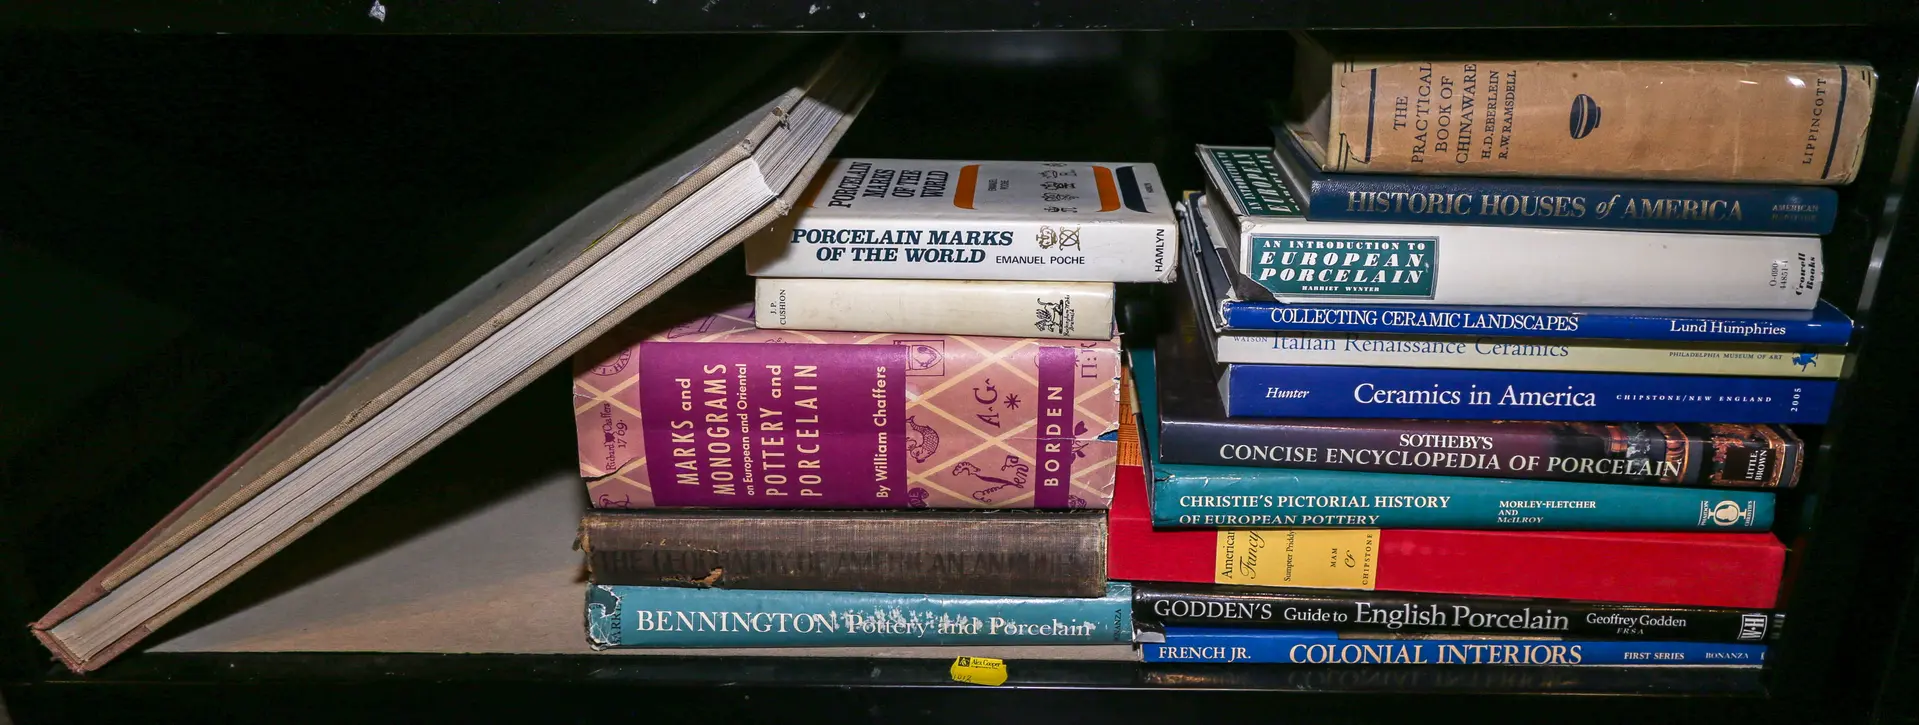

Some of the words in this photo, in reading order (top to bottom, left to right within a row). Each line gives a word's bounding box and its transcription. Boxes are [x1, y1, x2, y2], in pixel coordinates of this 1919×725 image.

[1441, 76, 1454, 102] OF
[1393, 96, 1408, 130] THE
[1411, 62, 1432, 164] PRACTICAL
[1456, 63, 1477, 164] CHINAWARE
[1802, 78, 1827, 165] LIPPINCOTT
[1434, 107, 1453, 153] BOOK
[828, 161, 873, 208] PORCELAIN
[862, 169, 896, 198] MARKS
[892, 183, 916, 198] OF
[901, 170, 922, 185] THE
[920, 170, 949, 198] WORLD
[1232, 152, 1292, 213] EUROPEAN
[1346, 190, 1472, 215] HISTORIC
[1479, 194, 1586, 218] HOUSES
[1595, 194, 1620, 219] of
[1621, 198, 1743, 221] AMERICA
[791, 228, 923, 245] PORCELAIN
[927, 230, 1014, 246] MARKS
[1155, 228, 1166, 272] HAMLYN
[1262, 240, 1281, 249] AN
[1289, 240, 1400, 250] INTRODUCTION
[1407, 242, 1426, 251] TO
[816, 247, 846, 261] OF
[850, 247, 898, 262] THE
[904, 248, 986, 263] WORLD
[996, 255, 1046, 265] EMANUEL
[1050, 256, 1085, 265] POCHE
[1259, 252, 1424, 267] EUROPEAN
[1259, 268, 1424, 284] PORCELAIN
[1795, 252, 1806, 295] Crowell
[1806, 256, 1816, 289] Books
[770, 300, 778, 315] J.P.
[779, 289, 787, 325] CUSHION
[1271, 307, 1378, 325] COLLECTING
[1381, 310, 1460, 328] CERAMIC
[1463, 313, 1579, 331] LANDSCAPES
[1670, 320, 1707, 333] Lund
[1710, 321, 1786, 336] Humphries
[1272, 331, 1336, 350] Italian
[1344, 333, 1466, 354] Renaissance
[1475, 337, 1569, 357] Ceramics
[675, 378, 691, 411] and
[735, 363, 747, 410] Oriental
[766, 364, 782, 399] and
[872, 366, 888, 426] Chaffers
[1266, 387, 1310, 399] Hunter
[1354, 383, 1461, 405] Ceramics
[1468, 385, 1491, 405] in
[1497, 386, 1596, 407] America
[1791, 388, 1801, 412] 2005
[703, 364, 736, 496] MONOGRAMS
[737, 413, 748, 434] and
[794, 365, 823, 497] PORCELAIN
[1043, 386, 1063, 487] BORDEN
[670, 420, 700, 486] MARKS
[759, 408, 788, 496] POTTERY
[1399, 433, 1493, 449] SOTHEBY'S
[606, 443, 617, 471] Richard
[743, 437, 755, 484] European
[873, 430, 888, 483] William
[1219, 444, 1317, 463] CONCISE
[1324, 448, 1501, 470] ENCYCLOPEDIA
[1509, 455, 1540, 471] OF
[1546, 456, 1682, 477] PORCELAIN
[1745, 450, 1758, 479] LITTLE,
[1755, 449, 1767, 480] BROWN
[747, 486, 755, 496] on
[876, 485, 891, 498] By
[1179, 495, 1273, 508] CHRISTIE'S
[1277, 496, 1370, 508] PICTORIAL
[1373, 496, 1451, 508] HISTORY
[1499, 500, 1596, 509] MORLEY-FLETCHER
[1179, 515, 1201, 525] OF
[1204, 515, 1296, 525] EUROPEAN
[1301, 515, 1380, 525] POTTERY
[1497, 516, 1543, 524] McILROY
[1240, 530, 1265, 579] Fancy
[1284, 554, 1295, 582] Sumpter
[1330, 547, 1338, 568] MAM
[1362, 533, 1374, 586] CHIPSTONE
[636, 610, 835, 634] BENNINGTON
[846, 613, 928, 638] Pottery
[937, 617, 978, 635] and
[988, 617, 1092, 636] Porcelain
[1154, 600, 1272, 620] GODDEN'S
[1283, 607, 1330, 622] Guide
[1333, 610, 1348, 623] to
[1354, 601, 1448, 629] English
[1451, 605, 1570, 631] Porcelain
[1586, 613, 1638, 628] Geoffrey
[1639, 615, 1687, 628] Godden
[1158, 646, 1226, 659] FRENCH
[1227, 647, 1251, 663] JR.
[1289, 644, 1427, 664] COLONIAL
[1436, 644, 1582, 665] INTERIORS
[1624, 652, 1650, 660] FIRST
[1653, 652, 1685, 660] SERIES
[1705, 652, 1749, 660] BONANZA
